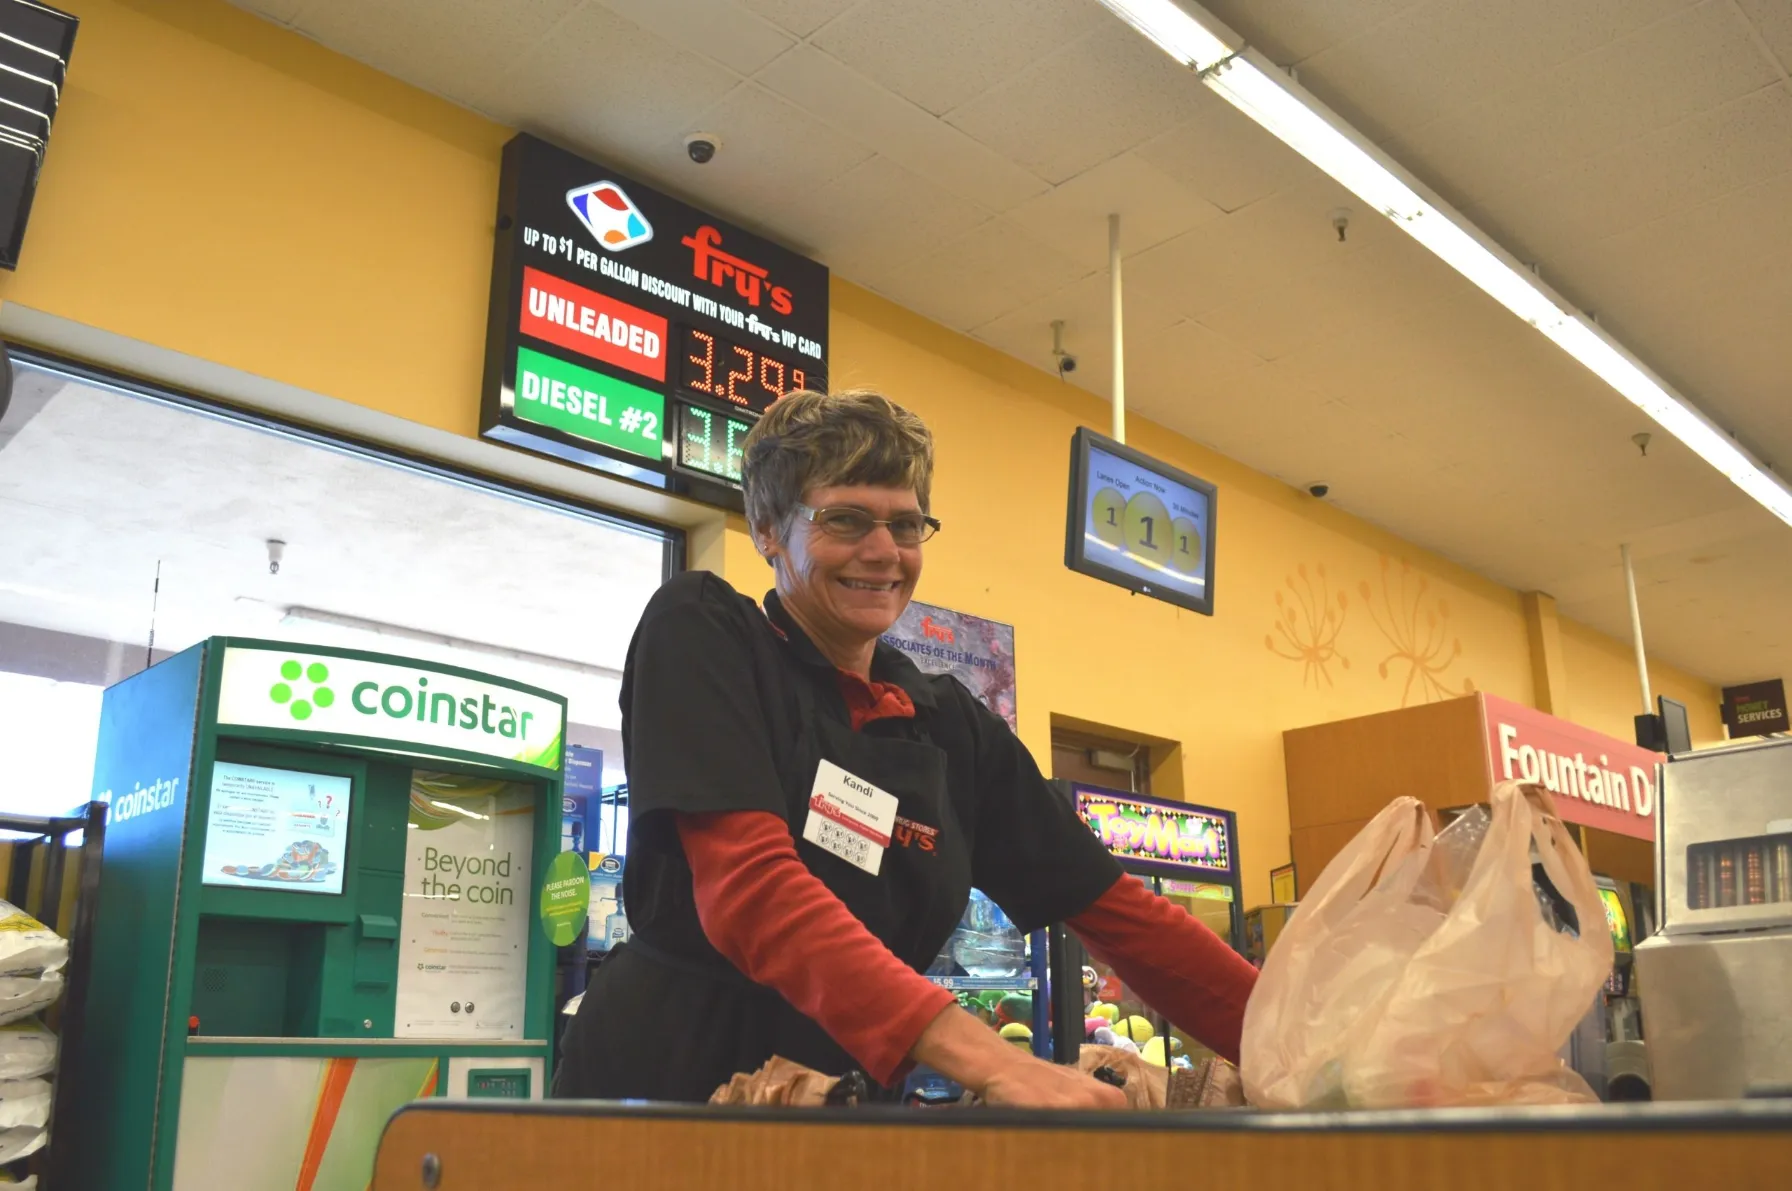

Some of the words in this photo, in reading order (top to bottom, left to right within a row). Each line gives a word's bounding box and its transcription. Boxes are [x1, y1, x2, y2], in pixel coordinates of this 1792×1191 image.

[681, 225, 793, 316] fry's
[524, 226, 540, 248] UP
[542, 233, 557, 256] TO
[559, 236, 573, 262] $1
[577, 247, 599, 272] PER
[600, 257, 640, 288] GALLON
[641, 273, 691, 308] DISCOUNT
[693, 293, 717, 319] WITH
[719, 304, 745, 330] YOUR
[781, 329, 797, 350] VIP
[798, 335, 822, 360] CARD
[528, 286, 661, 360] UNLEADED
[521, 369, 613, 427] DIESEL
[618, 405, 659, 441] #2
[1115, 478, 1131, 491] Open
[1153, 483, 1167, 494] Now
[1107, 506, 1117, 528] 1
[1139, 515, 1159, 551] 1
[1179, 535, 1190, 555] 1
[881, 634, 932, 657] SSOCIATES
[933, 646, 945, 659] OF
[947, 650, 963, 663] THE
[352, 677, 534, 741] coinstar
[1737, 708, 1783, 724] SERVICES
[1497, 722, 1631, 813] Fountain
[1630, 765, 1654, 817] D
[115, 777, 180, 823] coinstar
[843, 775, 874, 798] Kandi
[424, 846, 511, 880] Beyond
[421, 873, 462, 902] the
[466, 881, 514, 905] coin
[546, 880, 562, 892] PLEASE
[562, 876, 585, 889] PARDON
[551, 891, 561, 901] THE
